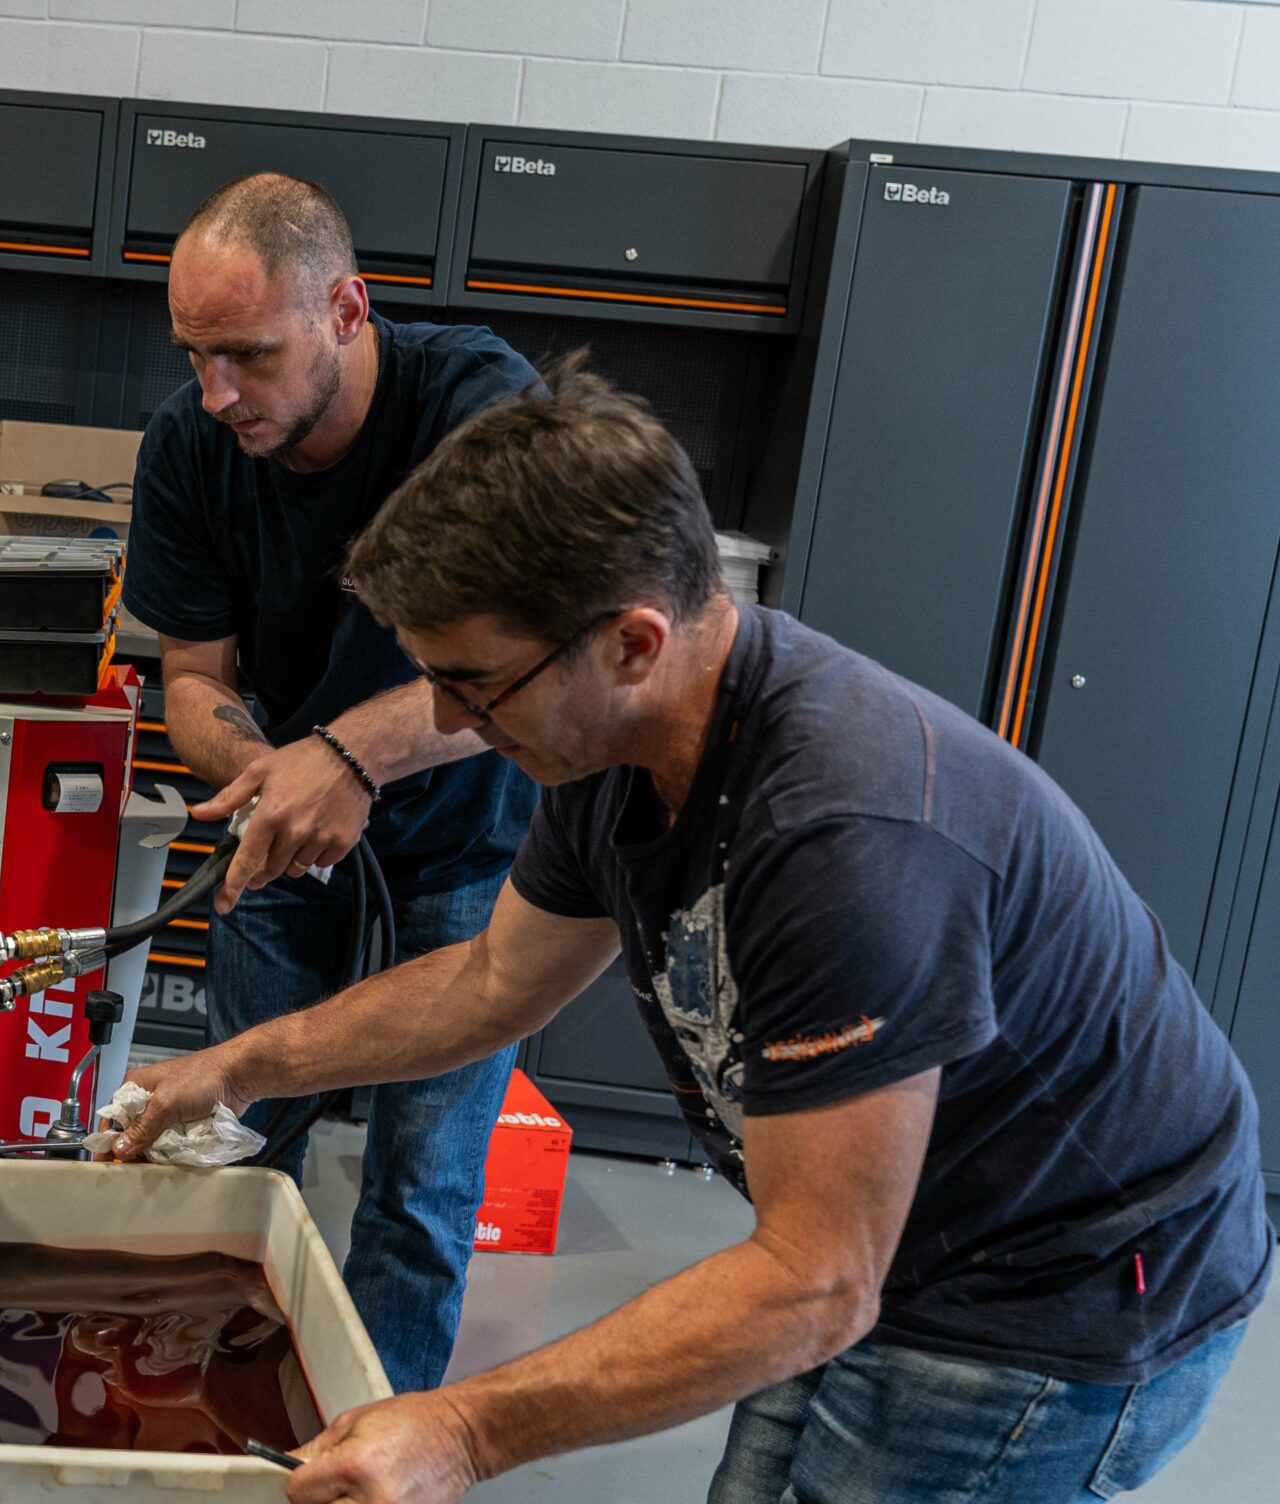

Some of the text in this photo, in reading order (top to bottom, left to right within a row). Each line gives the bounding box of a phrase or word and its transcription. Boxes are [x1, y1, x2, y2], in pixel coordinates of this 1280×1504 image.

[163, 130, 206, 148] Beta
[511, 156, 556, 176] Beta
[901, 183, 950, 205] Beta
[475, 1222, 502, 1241] tic
